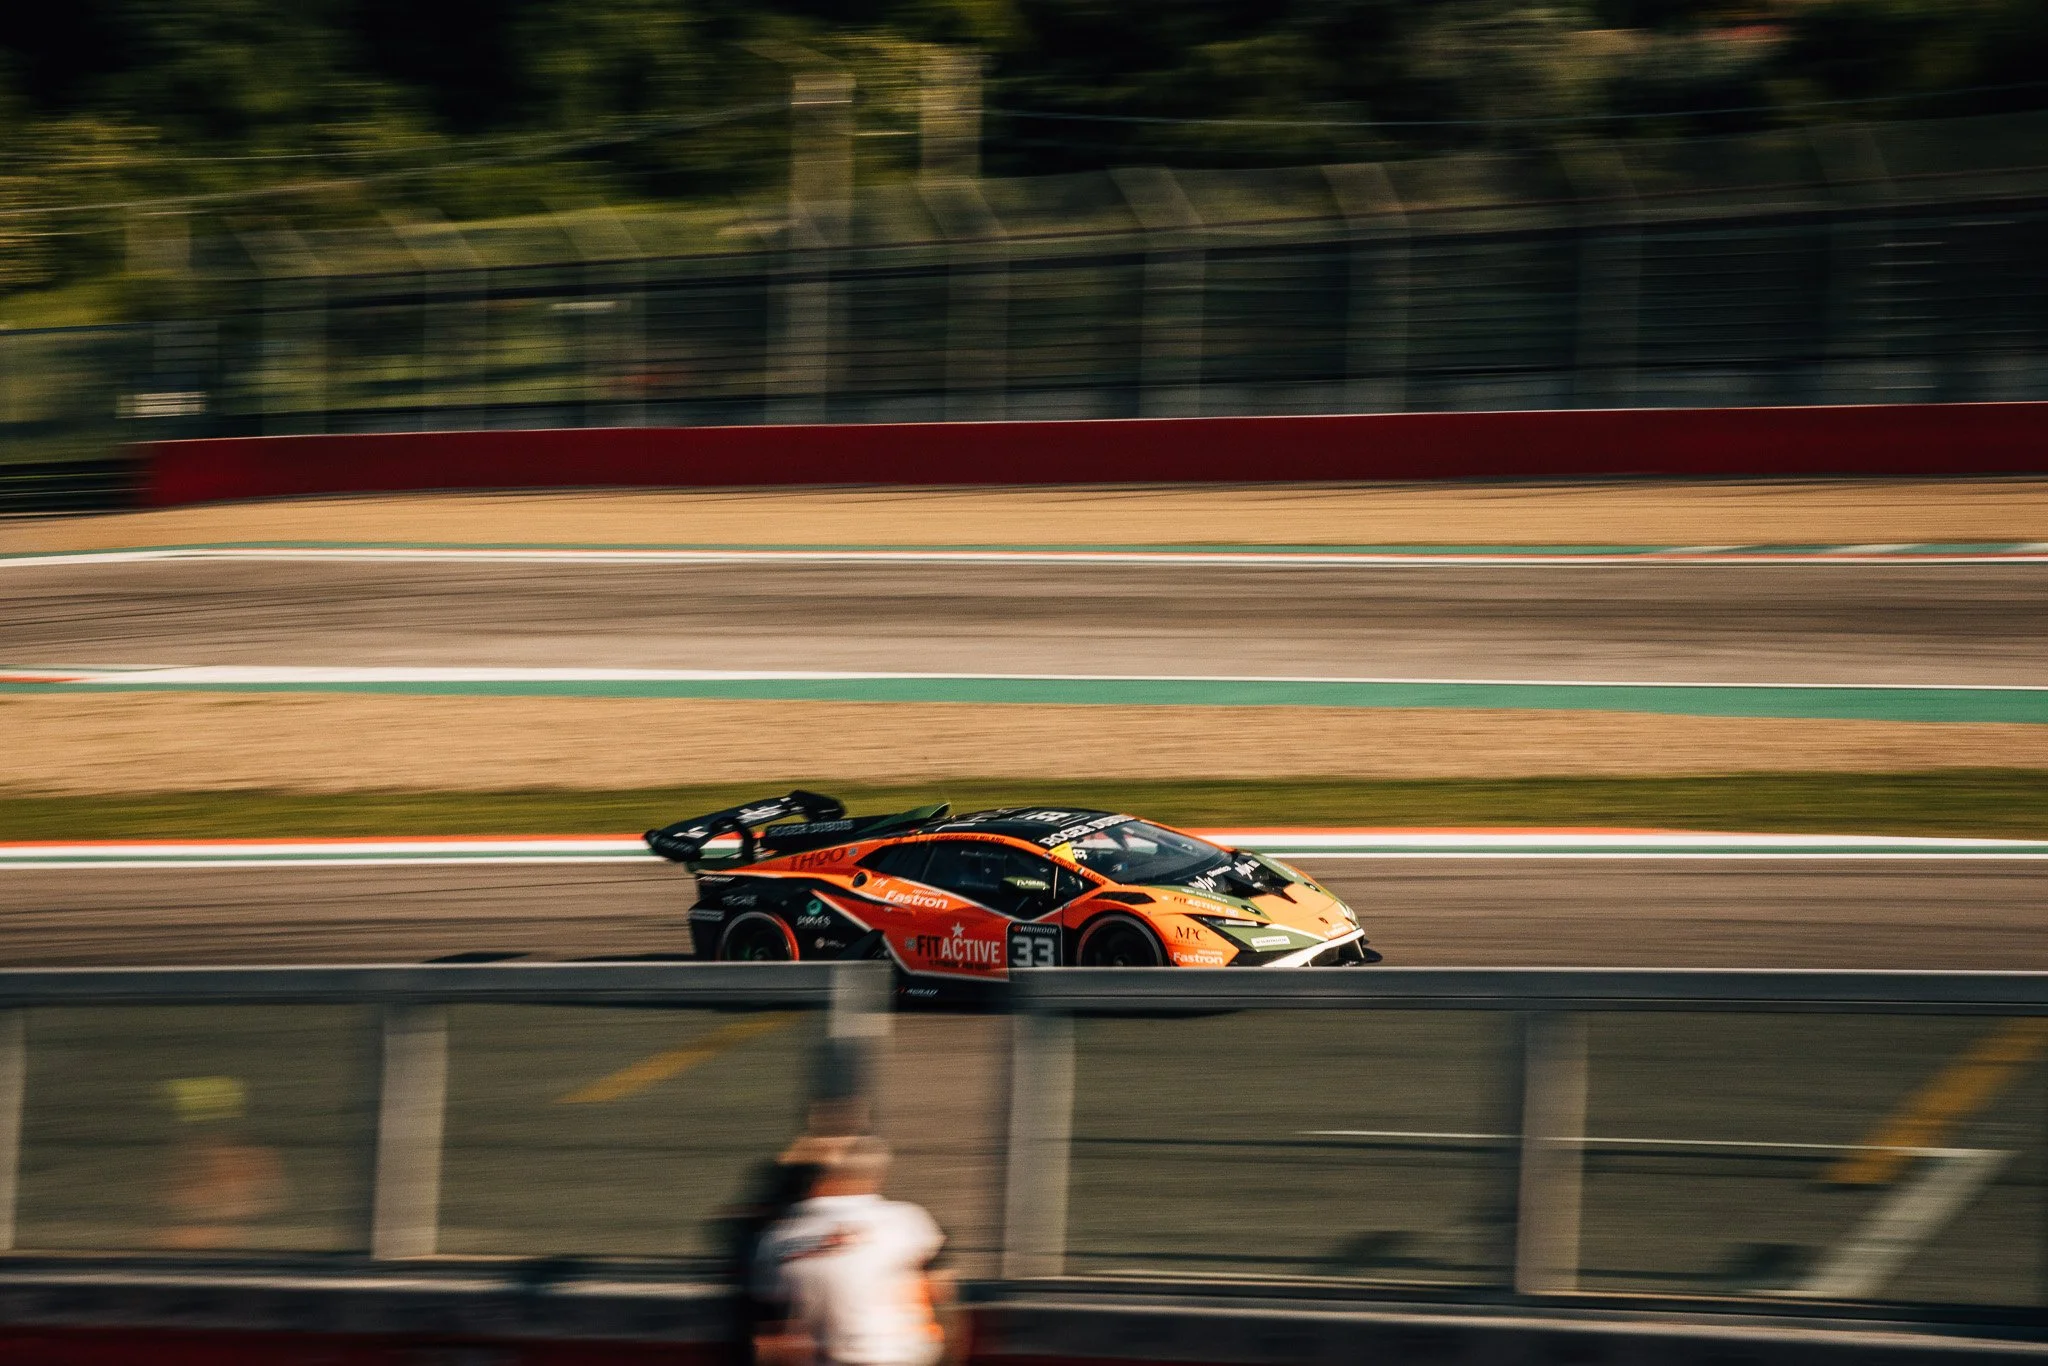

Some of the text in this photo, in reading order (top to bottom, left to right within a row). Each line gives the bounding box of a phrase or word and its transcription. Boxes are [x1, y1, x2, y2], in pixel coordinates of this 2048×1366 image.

[884, 889, 948, 910] Fastron
[1175, 926, 1208, 941] MPC
[1011, 935, 1055, 967] 33
[1173, 952, 1223, 964] Fastron
